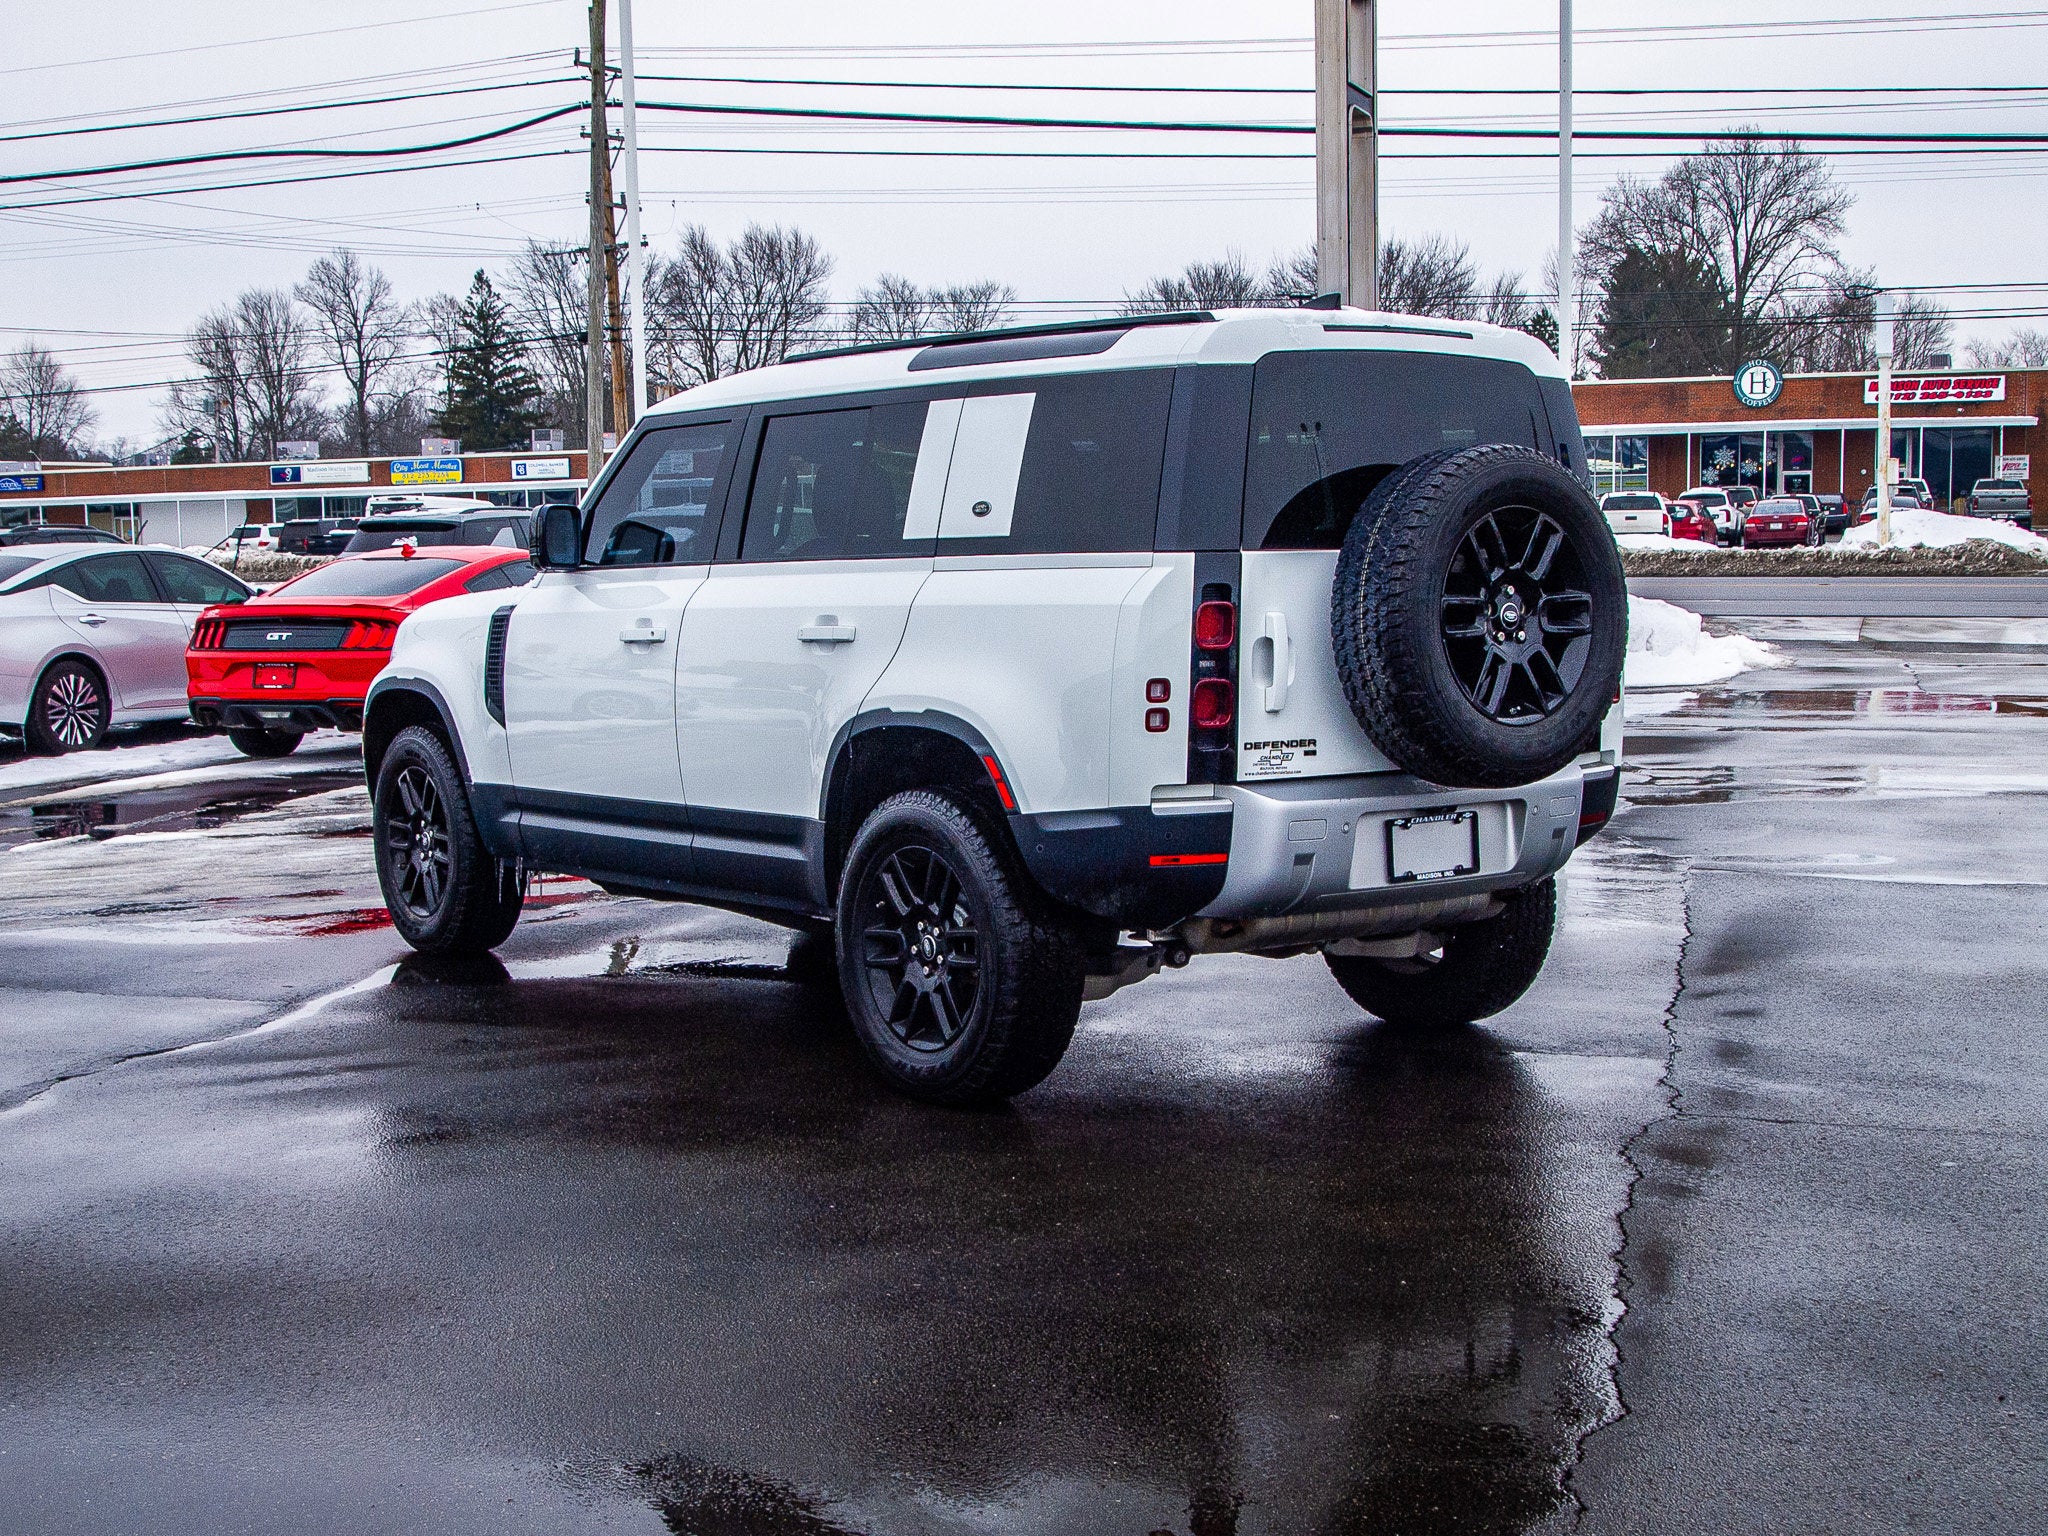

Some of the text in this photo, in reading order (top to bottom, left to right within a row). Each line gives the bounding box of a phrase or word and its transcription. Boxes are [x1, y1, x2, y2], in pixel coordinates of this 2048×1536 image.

[1748, 359, 1768, 367] HOS
[1921, 379, 1952, 390] AUTO
[1952, 378, 2001, 389] SERVICE
[1742, 396, 1774, 407] COFFEE
[394, 462, 408, 473] City
[266, 632, 293, 641] GT
[1244, 739, 1318, 751] DEFENDER
[1410, 813, 1458, 824] CHANDLER
